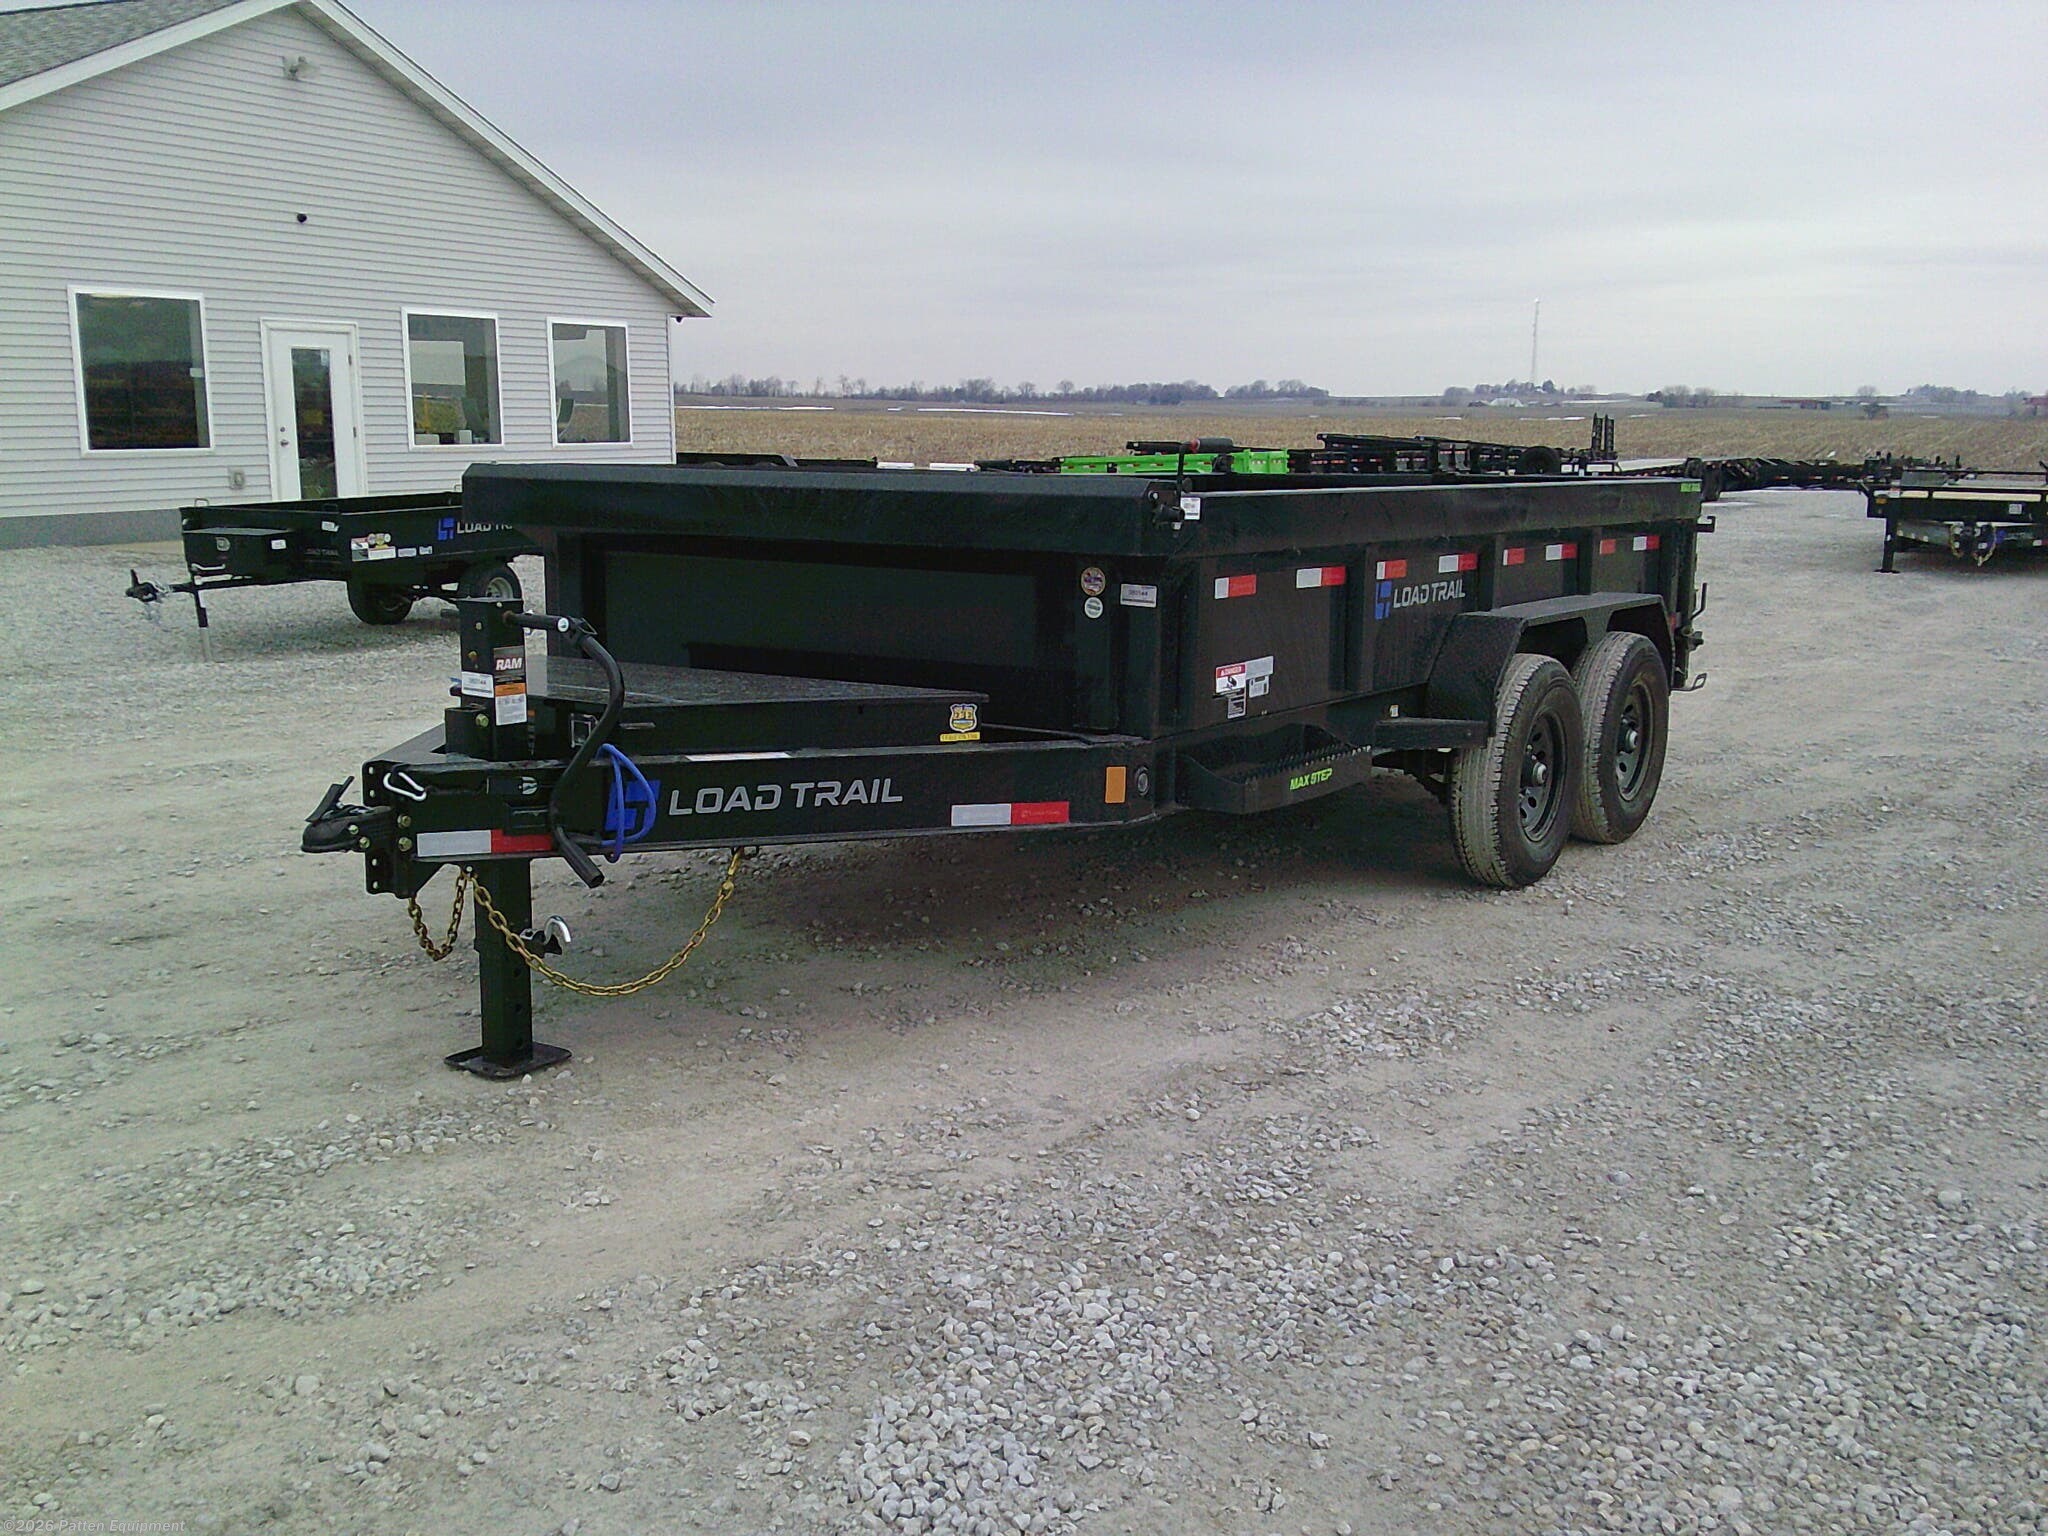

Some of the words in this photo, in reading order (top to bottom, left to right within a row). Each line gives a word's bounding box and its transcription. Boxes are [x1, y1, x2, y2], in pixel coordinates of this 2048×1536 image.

[1393, 584, 1430, 608] LOAD
[1431, 579, 1466, 602] TRAIL
[495, 657, 523, 671] RAM
[1290, 774, 1310, 790] MAX
[668, 783, 783, 816] LOAD
[790, 778, 903, 808] TRAIL
